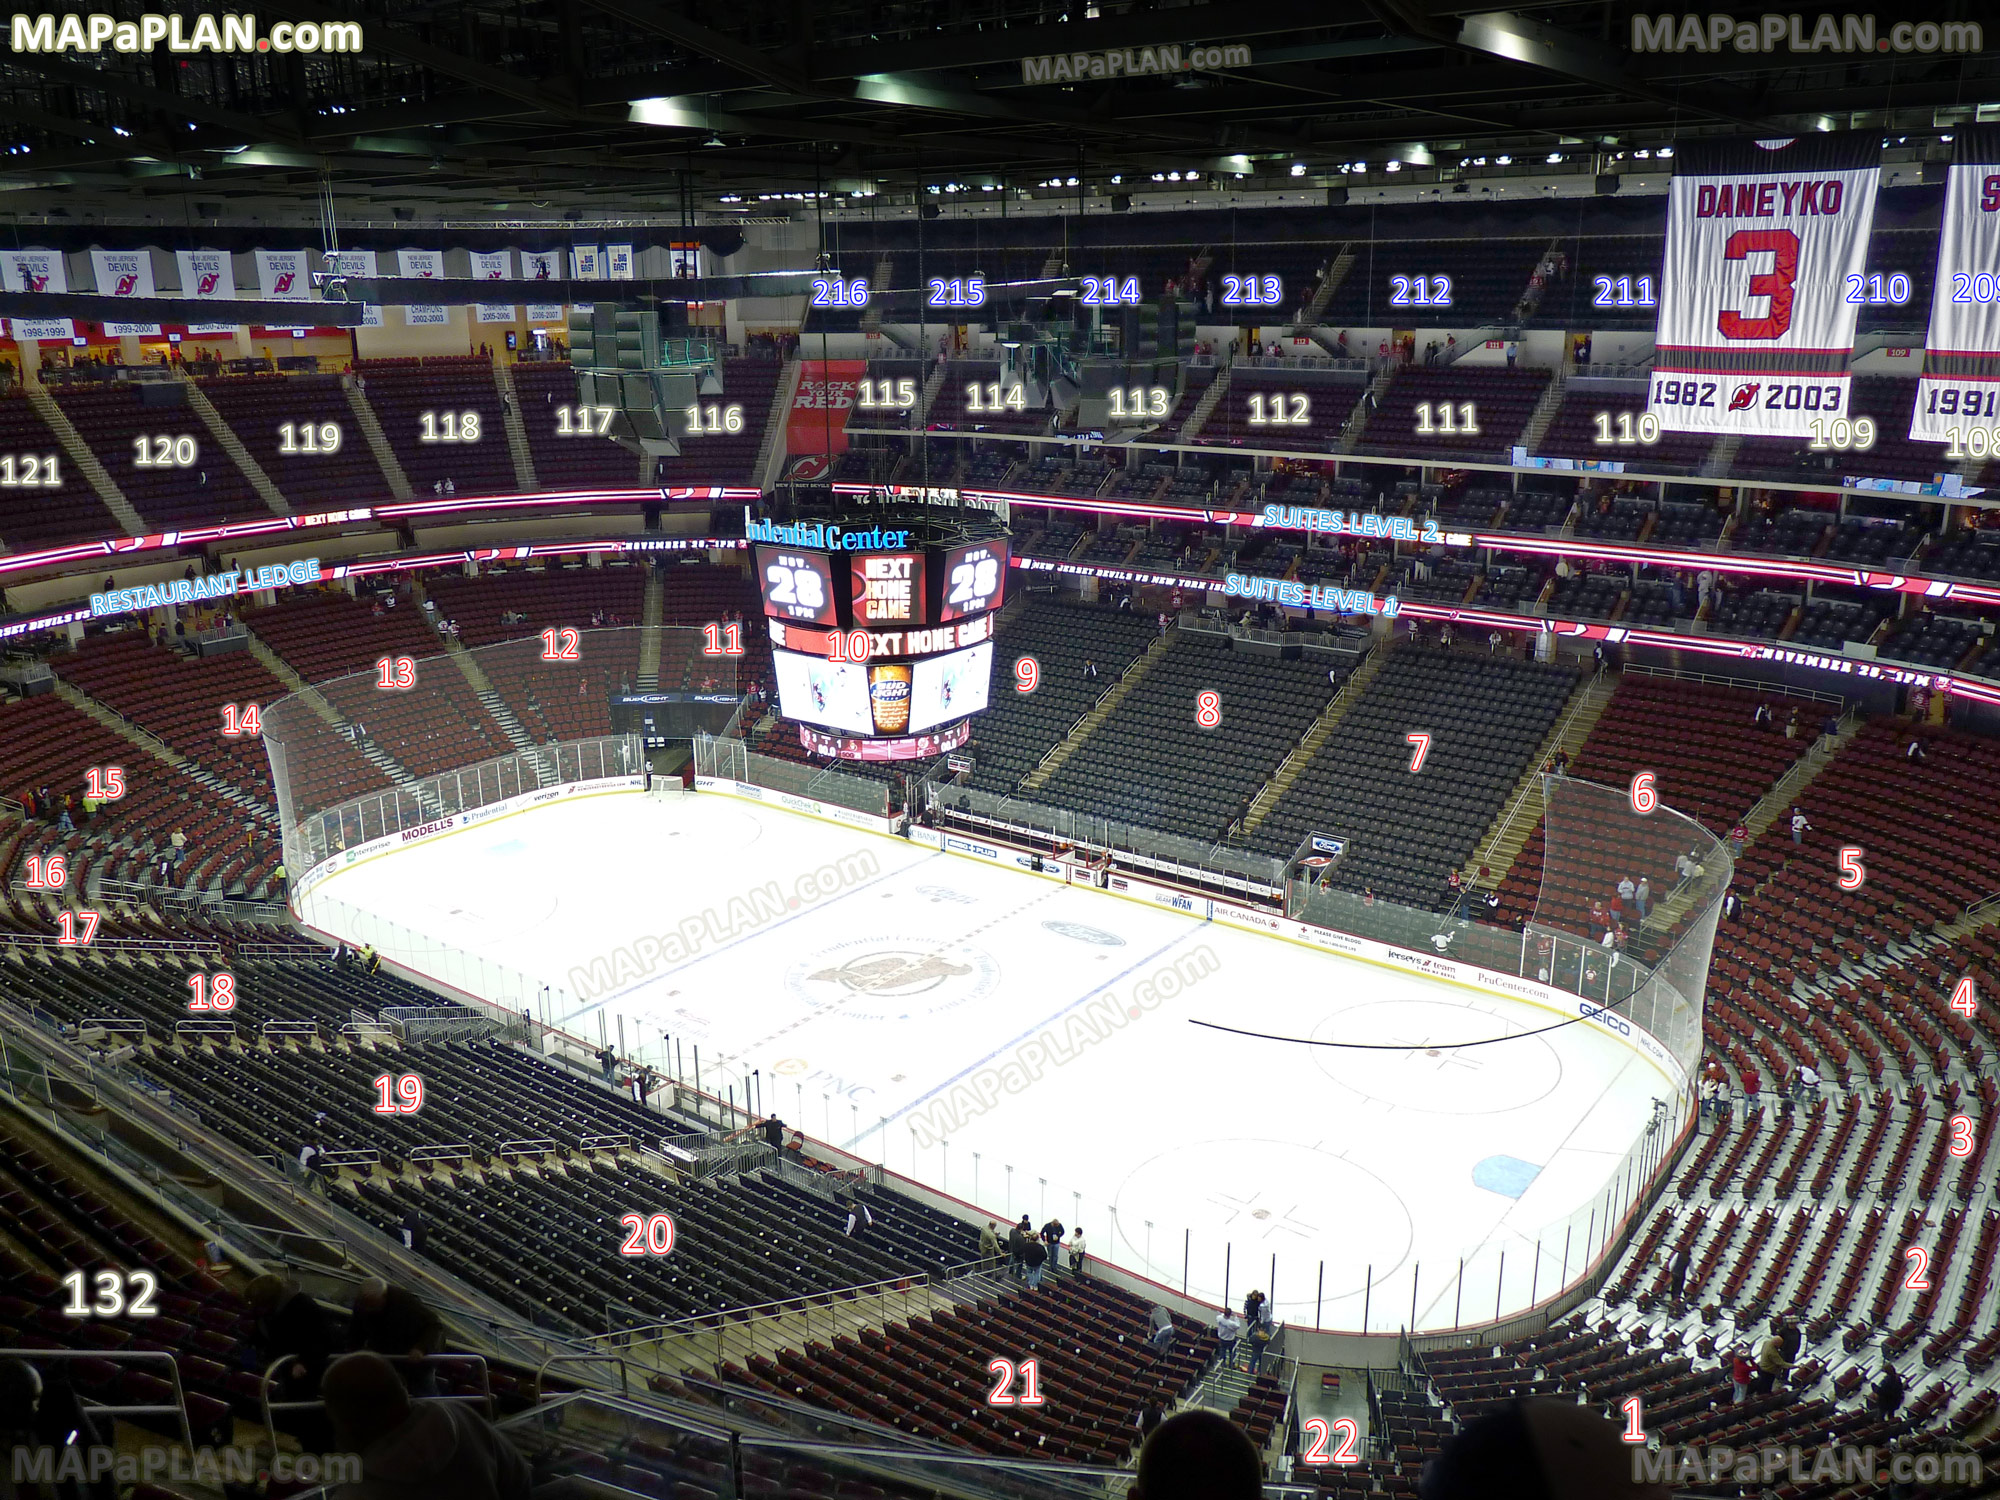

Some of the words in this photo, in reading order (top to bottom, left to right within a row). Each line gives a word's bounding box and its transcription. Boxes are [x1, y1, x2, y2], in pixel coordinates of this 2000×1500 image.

[1697, 179, 1842, 219] DANEYKO
[585, 255, 594, 264] BIG
[618, 254, 627, 262] BIG
[108, 263, 138, 272] DEVILS
[192, 262, 219, 271] DEVILS
[269, 262, 296, 271] DEVILS
[341, 262, 366, 270] DEVILS
[410, 261, 433, 270] DEVILS
[481, 261, 502, 269] DEVILS
[581, 264, 594, 273] EAST
[614, 263, 627, 272] EAST
[1717, 228, 1800, 341] 3
[413, 315, 444, 323] 2002-2003
[22, 327, 66, 337] 1998-1999
[1890, 349, 1906, 357] 109
[793, 396, 854, 409] RED
[1653, 380, 1717, 408] 1982
[1764, 383, 1842, 412] 2003
[1927, 389, 1996, 417] 1991
[747, 517, 826, 549] udential
[825, 525, 909, 551] Center
[625, 540, 687, 550] NOVEMBER
[864, 557, 914, 579] NEXT
[948, 558, 999, 604] 28
[1032, 560, 1055, 571] NEW
[1057, 564, 1095, 577] JERSEY
[1095, 569, 1132, 581] DEVILS
[1150, 576, 1176, 587] NEW
[1177, 579, 1207, 591] YORK
[766, 565, 825, 608] 28
[865, 579, 912, 600] HOME
[865, 600, 911, 619] GAME
[28, 613, 73, 632] DEVILS
[906, 625, 956, 655] HOME
[1761, 647, 1853, 674] NOVEMBER
[1894, 670, 1932, 688] 1PM
[877, 681, 907, 690] BUD
[873, 688, 910, 697] LIGHT
[534, 791, 559, 801] verizon
[471, 803, 508, 820] Prudential
[402, 818, 454, 841] MODELL'S
[917, 831, 937, 842] BANK
[1321, 839, 1338, 850] Ford
[346, 841, 391, 863] enterprise
[1172, 896, 1192, 911] WFAN
[1214, 907, 1229, 915] AIR
[1230, 910, 1267, 926] CANADA
[1314, 929, 1332, 938] PLEASE
[1332, 933, 1344, 941] GIVE
[1433, 962, 1456, 973] team
[1478, 972, 1549, 1000] PruCenter.com
[1579, 1003, 1631, 1037] GEICO
